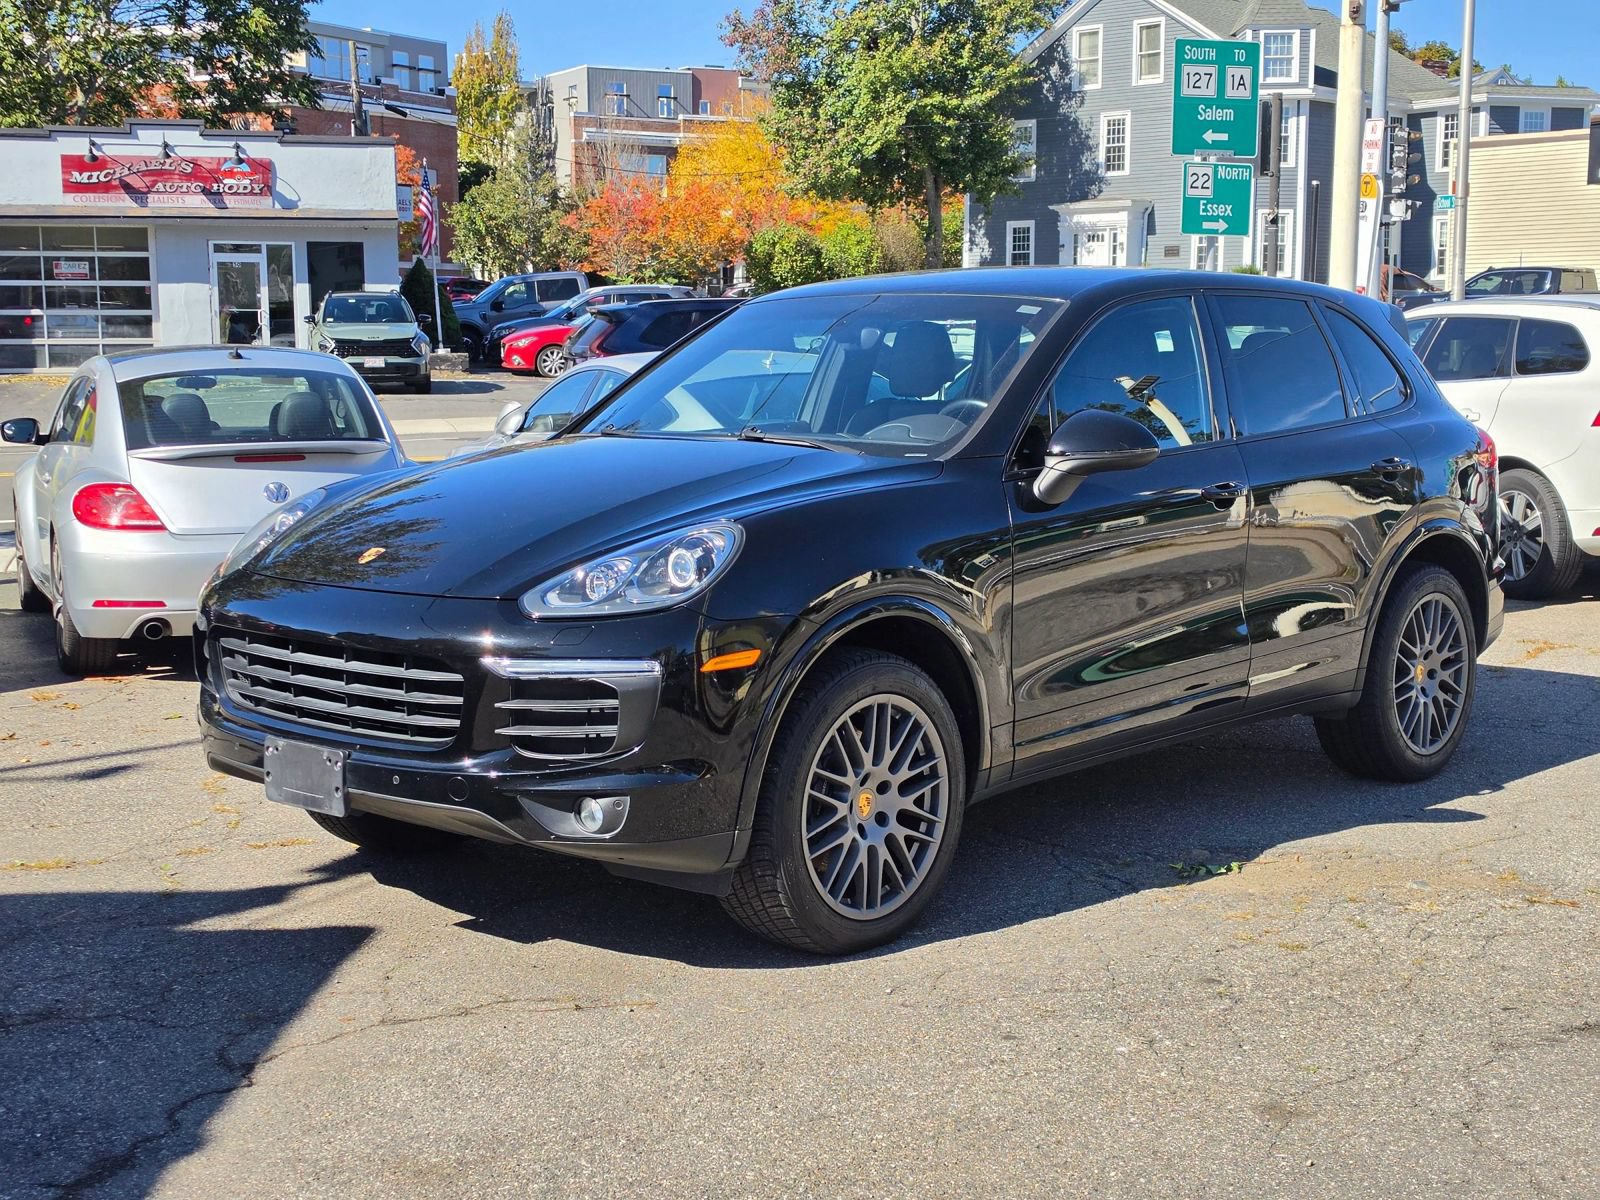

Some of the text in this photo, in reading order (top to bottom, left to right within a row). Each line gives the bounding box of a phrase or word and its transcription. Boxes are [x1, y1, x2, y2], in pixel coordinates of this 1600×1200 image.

[1184, 45, 1246, 62] SOUTH TO
[1186, 72, 1247, 91] 127 1A
[1197, 104, 1234, 121] Salem
[69, 158, 194, 183] MICHAEL'S
[1190, 165, 1250, 190] 22 NORTH
[151, 182, 265, 194] AUTO BODY
[73, 194, 126, 204] COLLISION
[130, 194, 186, 204] SPECIALISTS
[1200, 200, 1233, 216] Essex
